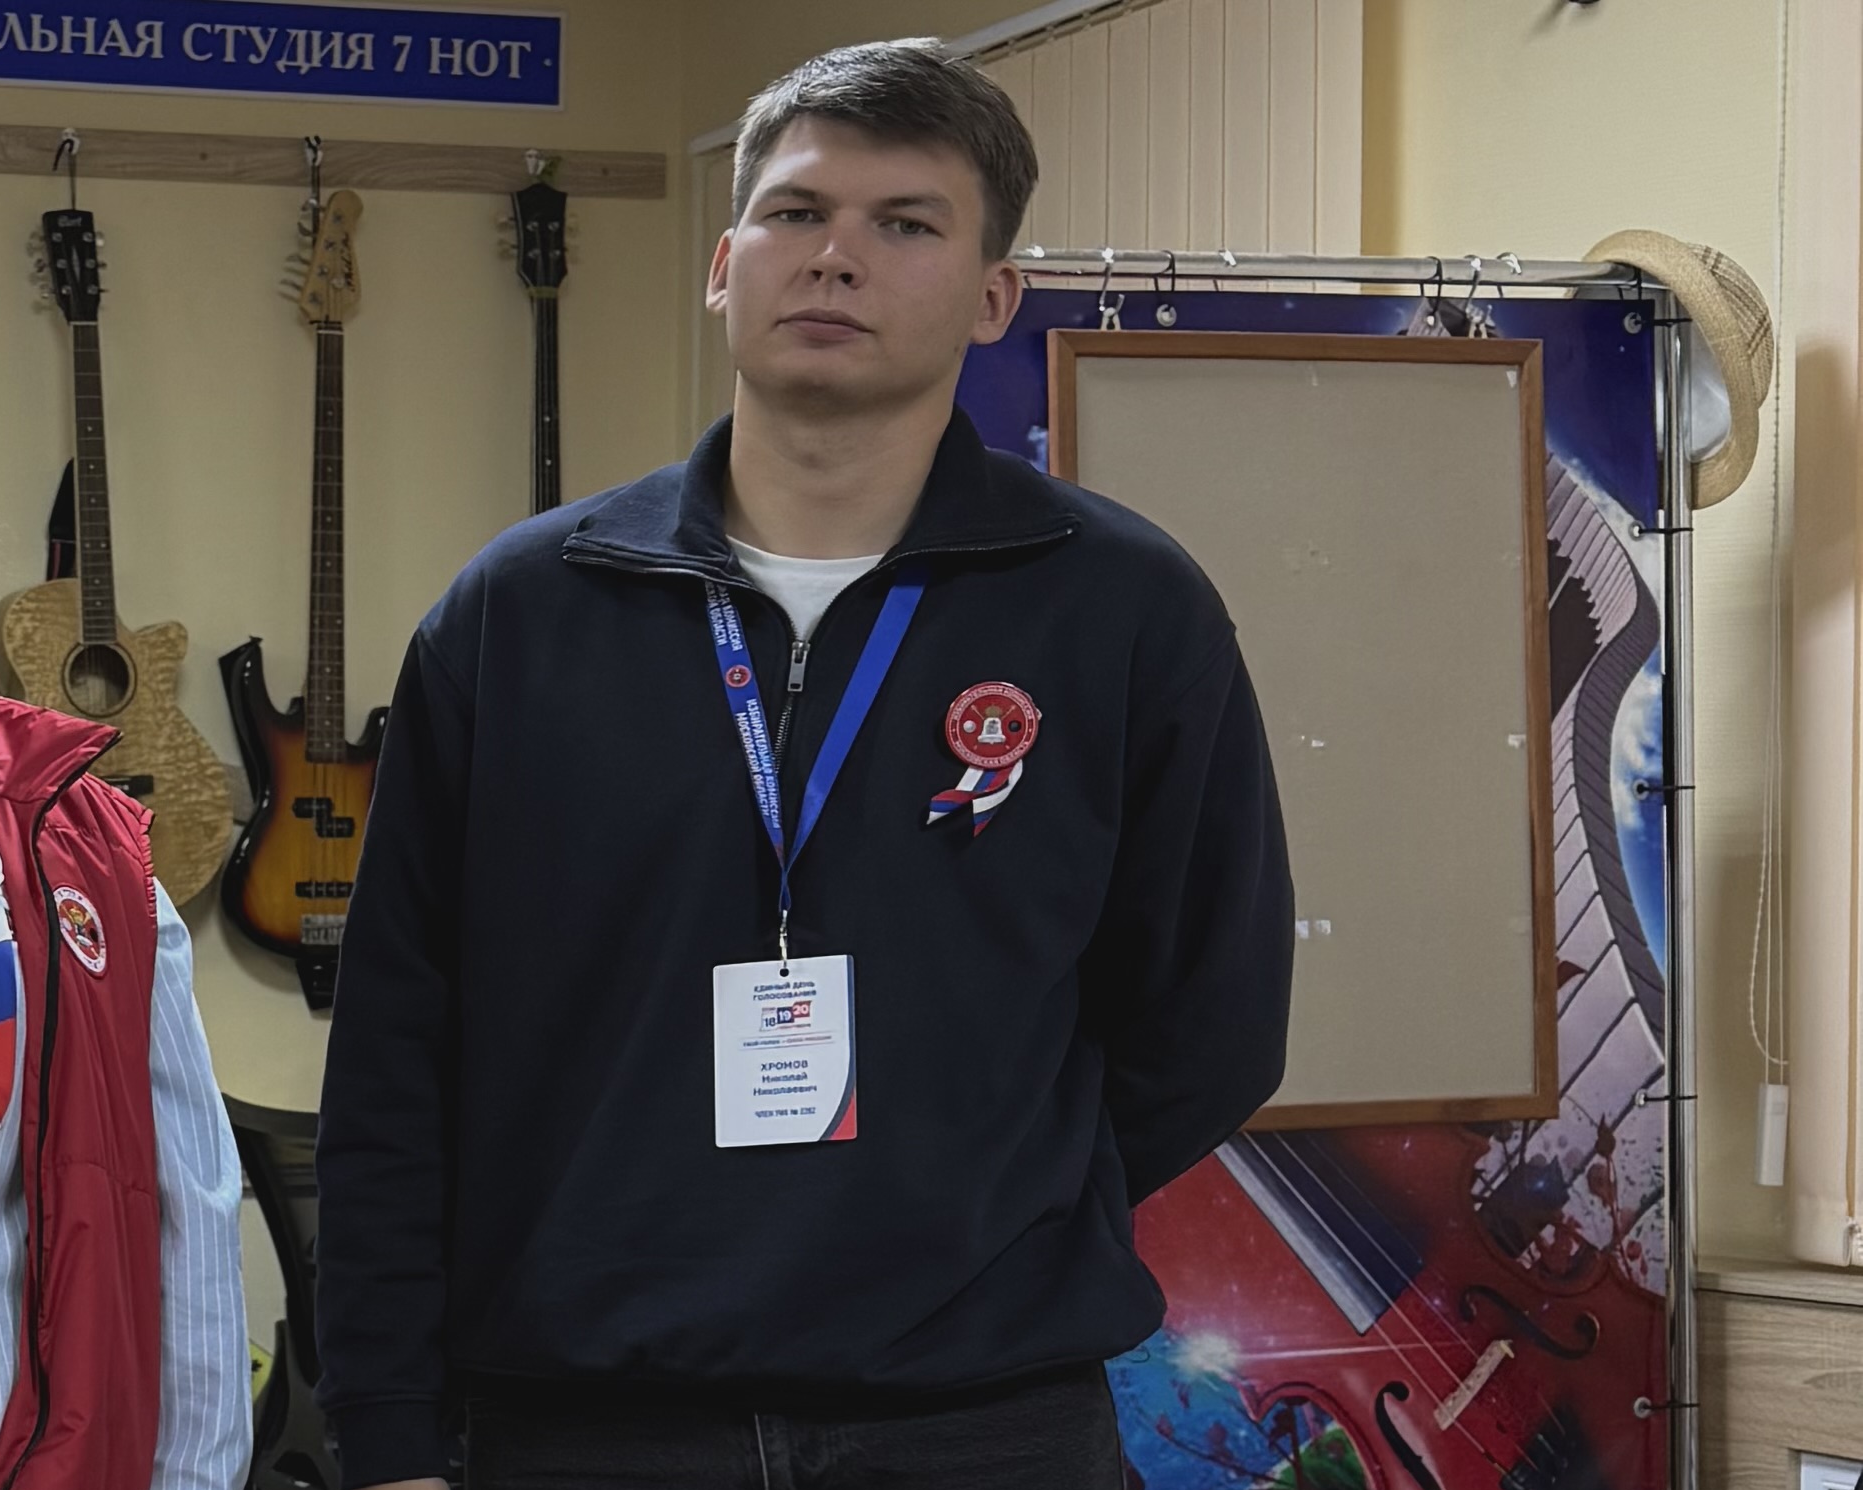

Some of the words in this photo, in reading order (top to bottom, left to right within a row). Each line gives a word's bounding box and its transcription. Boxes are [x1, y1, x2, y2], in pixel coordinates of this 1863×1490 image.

[182, 22, 375, 76] СТУДИЯ
[391, 35, 413, 73] 7
[428, 37, 532, 79] НОТ
[753, 990, 817, 1001] ГОЛОСОВАНИЯ
[765, 1017, 776, 1027] 18
[779, 1010, 792, 1021] 19
[793, 1004, 809, 1015] 20
